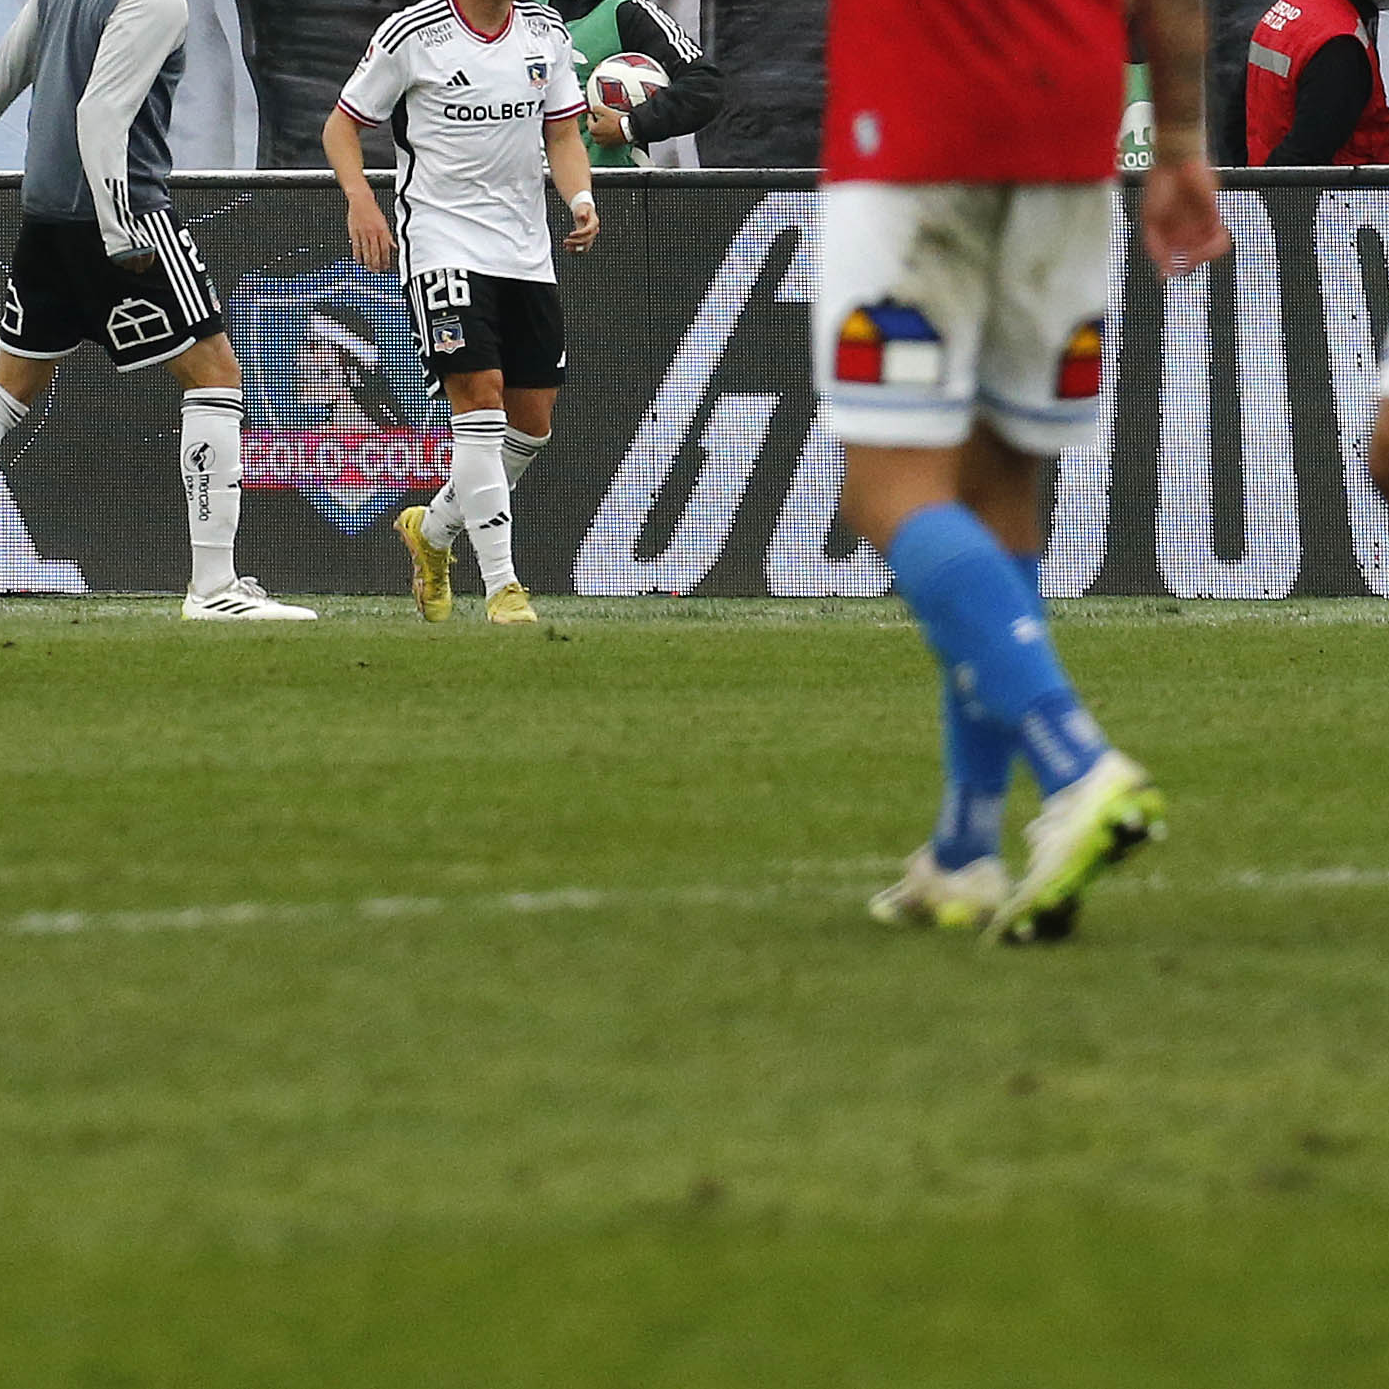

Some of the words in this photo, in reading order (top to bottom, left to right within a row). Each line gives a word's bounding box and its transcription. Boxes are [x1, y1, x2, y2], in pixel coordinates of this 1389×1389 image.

[416, 21, 453, 42] Pilsen
[444, 101, 536, 122] COOLBET
[425, 268, 471, 310] 26
[198, 473, 210, 523] mercado
